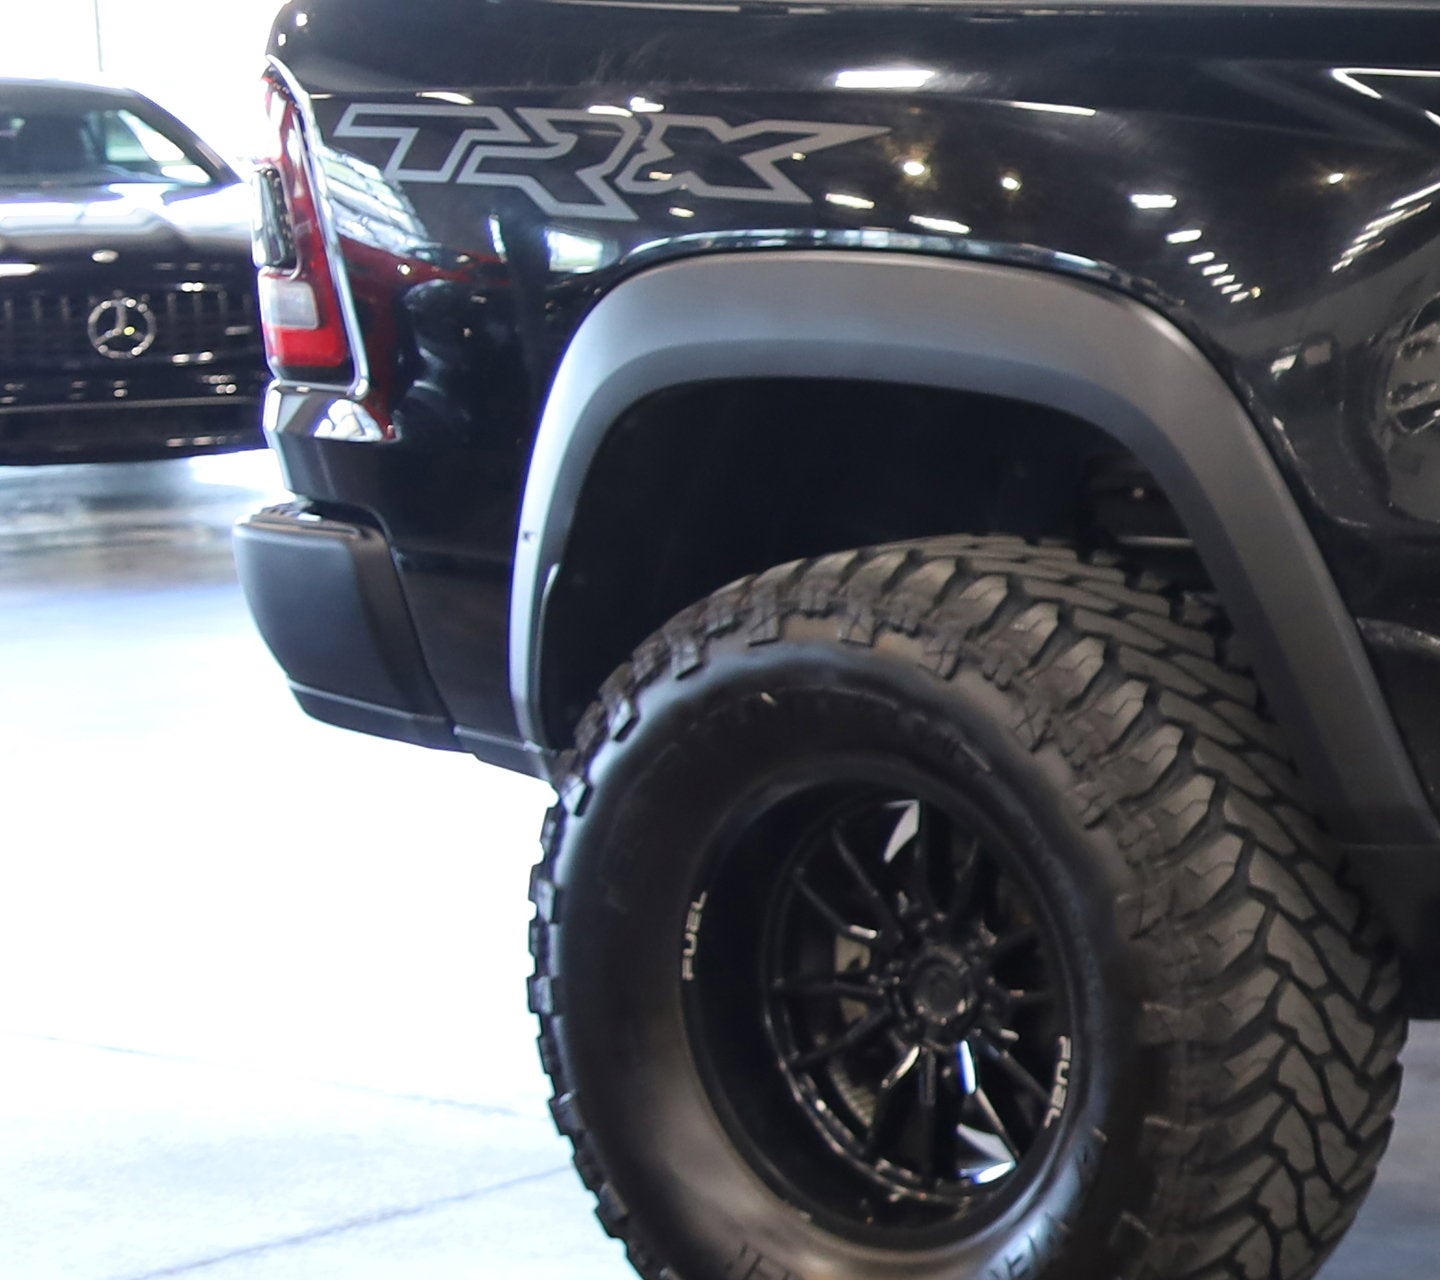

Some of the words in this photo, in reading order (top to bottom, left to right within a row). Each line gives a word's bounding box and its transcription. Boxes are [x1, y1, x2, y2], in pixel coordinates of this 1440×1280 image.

[333, 102, 893, 221] TRX
[681, 890, 709, 981] FUEL
[1043, 1034, 1072, 1130] FUEL
